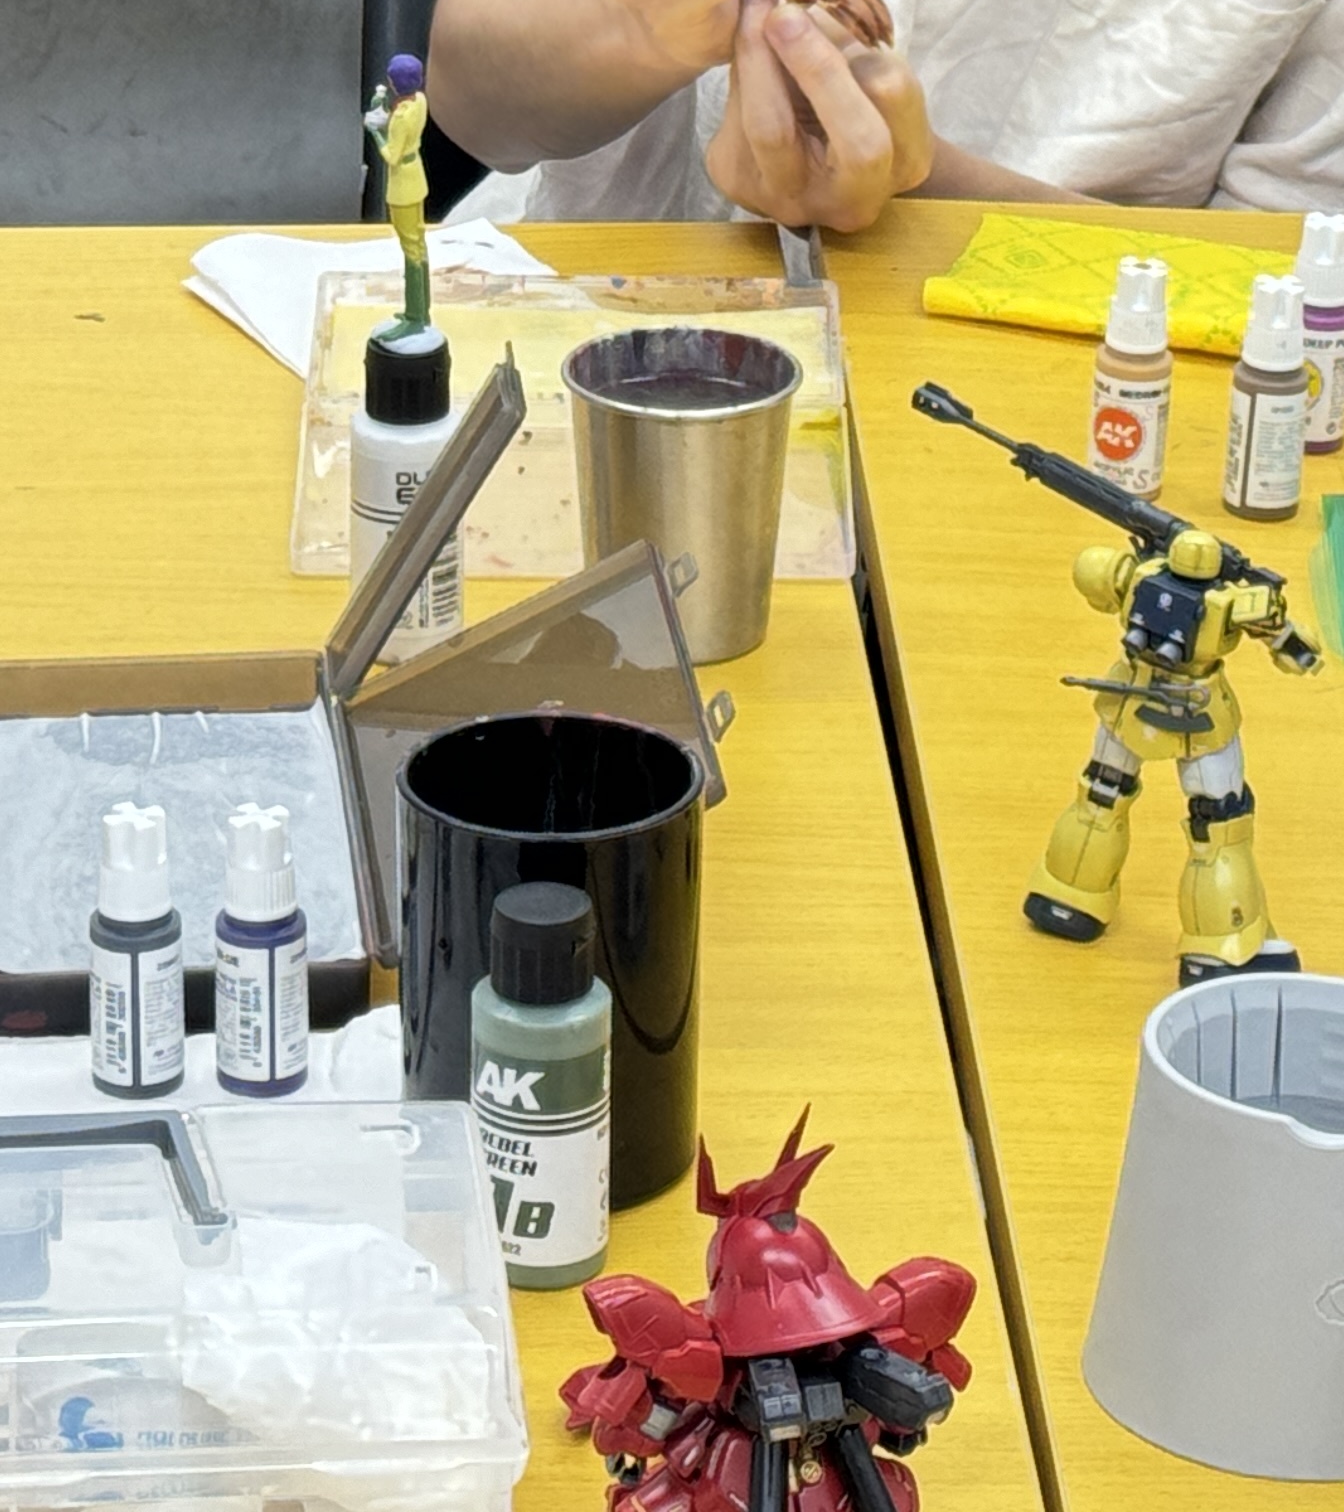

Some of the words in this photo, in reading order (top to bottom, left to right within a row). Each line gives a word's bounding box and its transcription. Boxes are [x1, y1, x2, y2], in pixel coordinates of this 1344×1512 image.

[1096, 420, 1138, 449] AK
[476, 1060, 546, 1111] AK
[484, 1149, 538, 1178] REEN
